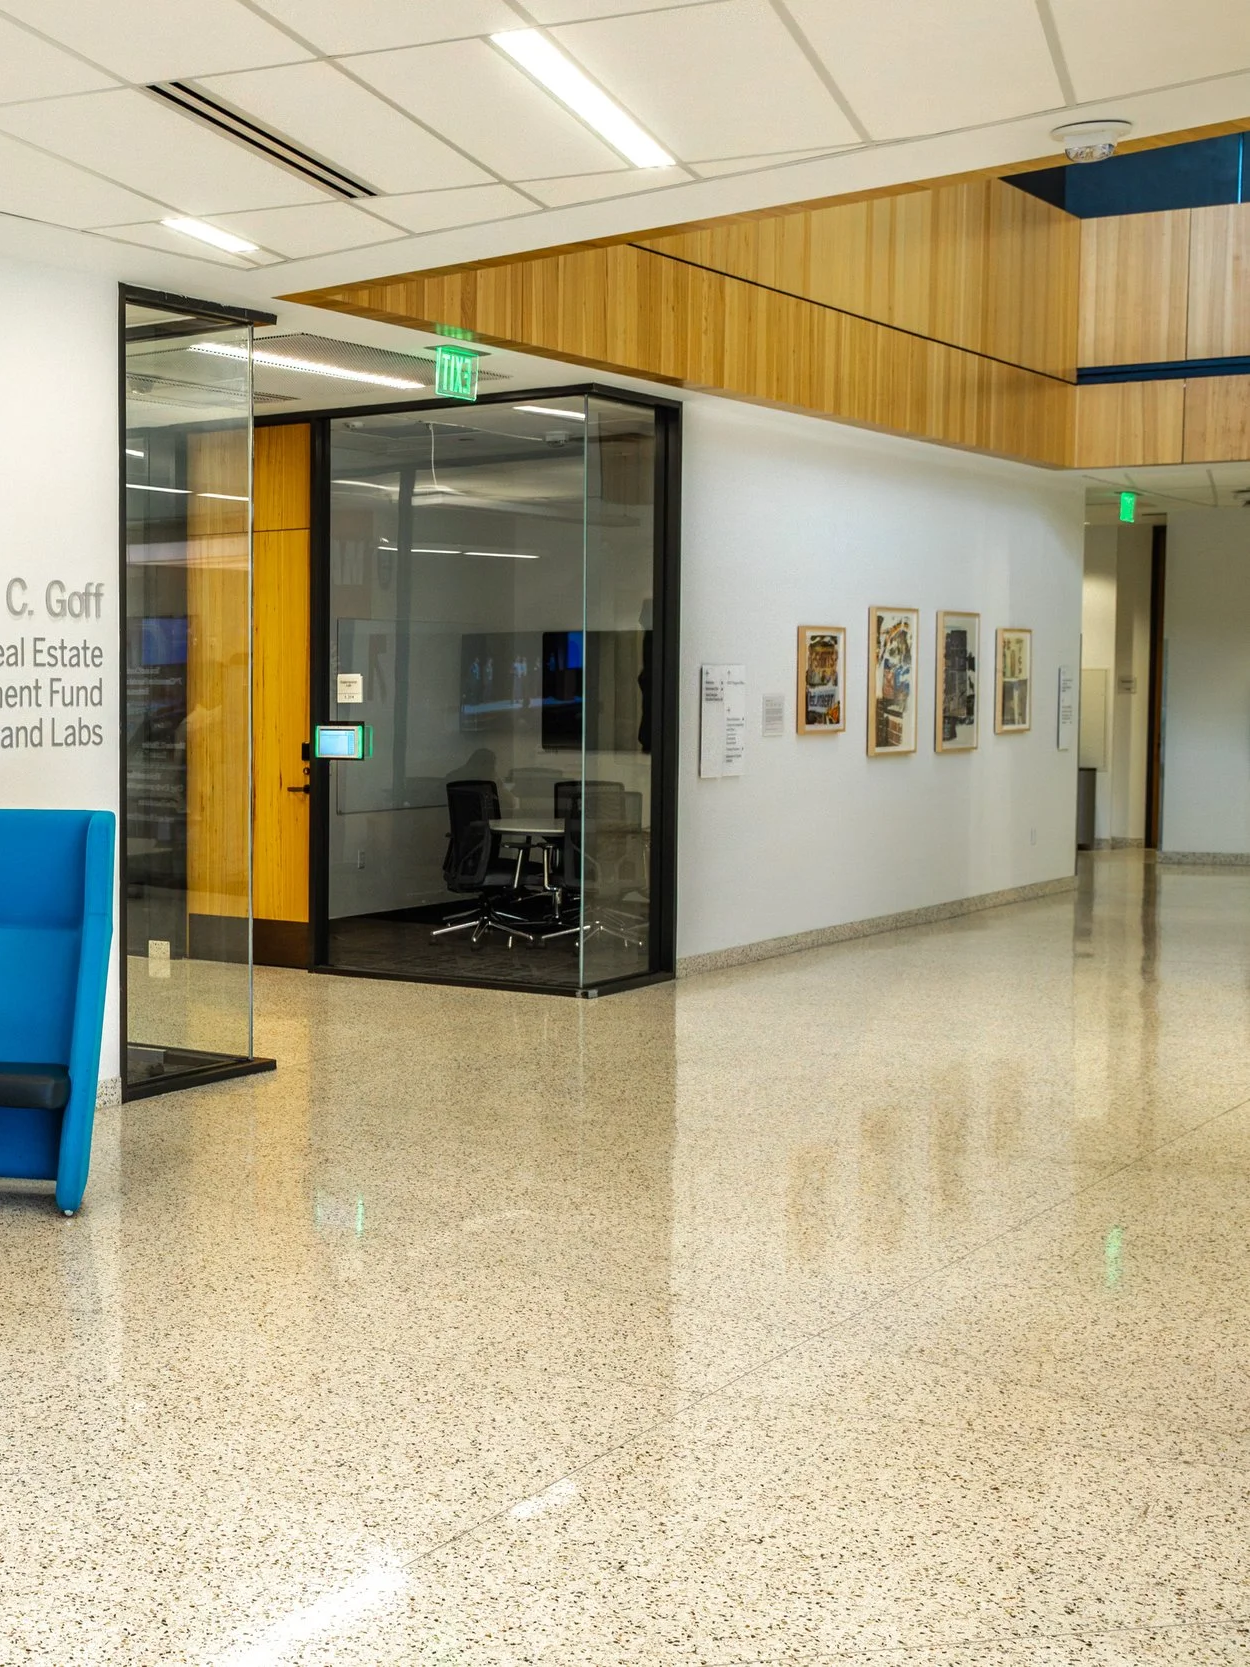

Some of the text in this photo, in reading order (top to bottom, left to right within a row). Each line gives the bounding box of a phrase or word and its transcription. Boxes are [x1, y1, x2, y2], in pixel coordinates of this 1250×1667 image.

[6, 577, 35, 616] C.
[45, 580, 105, 619] Goff
[33, 637, 104, 668] Estate
[50, 678, 103, 708] Fund
[0, 717, 104, 749] and Labs
